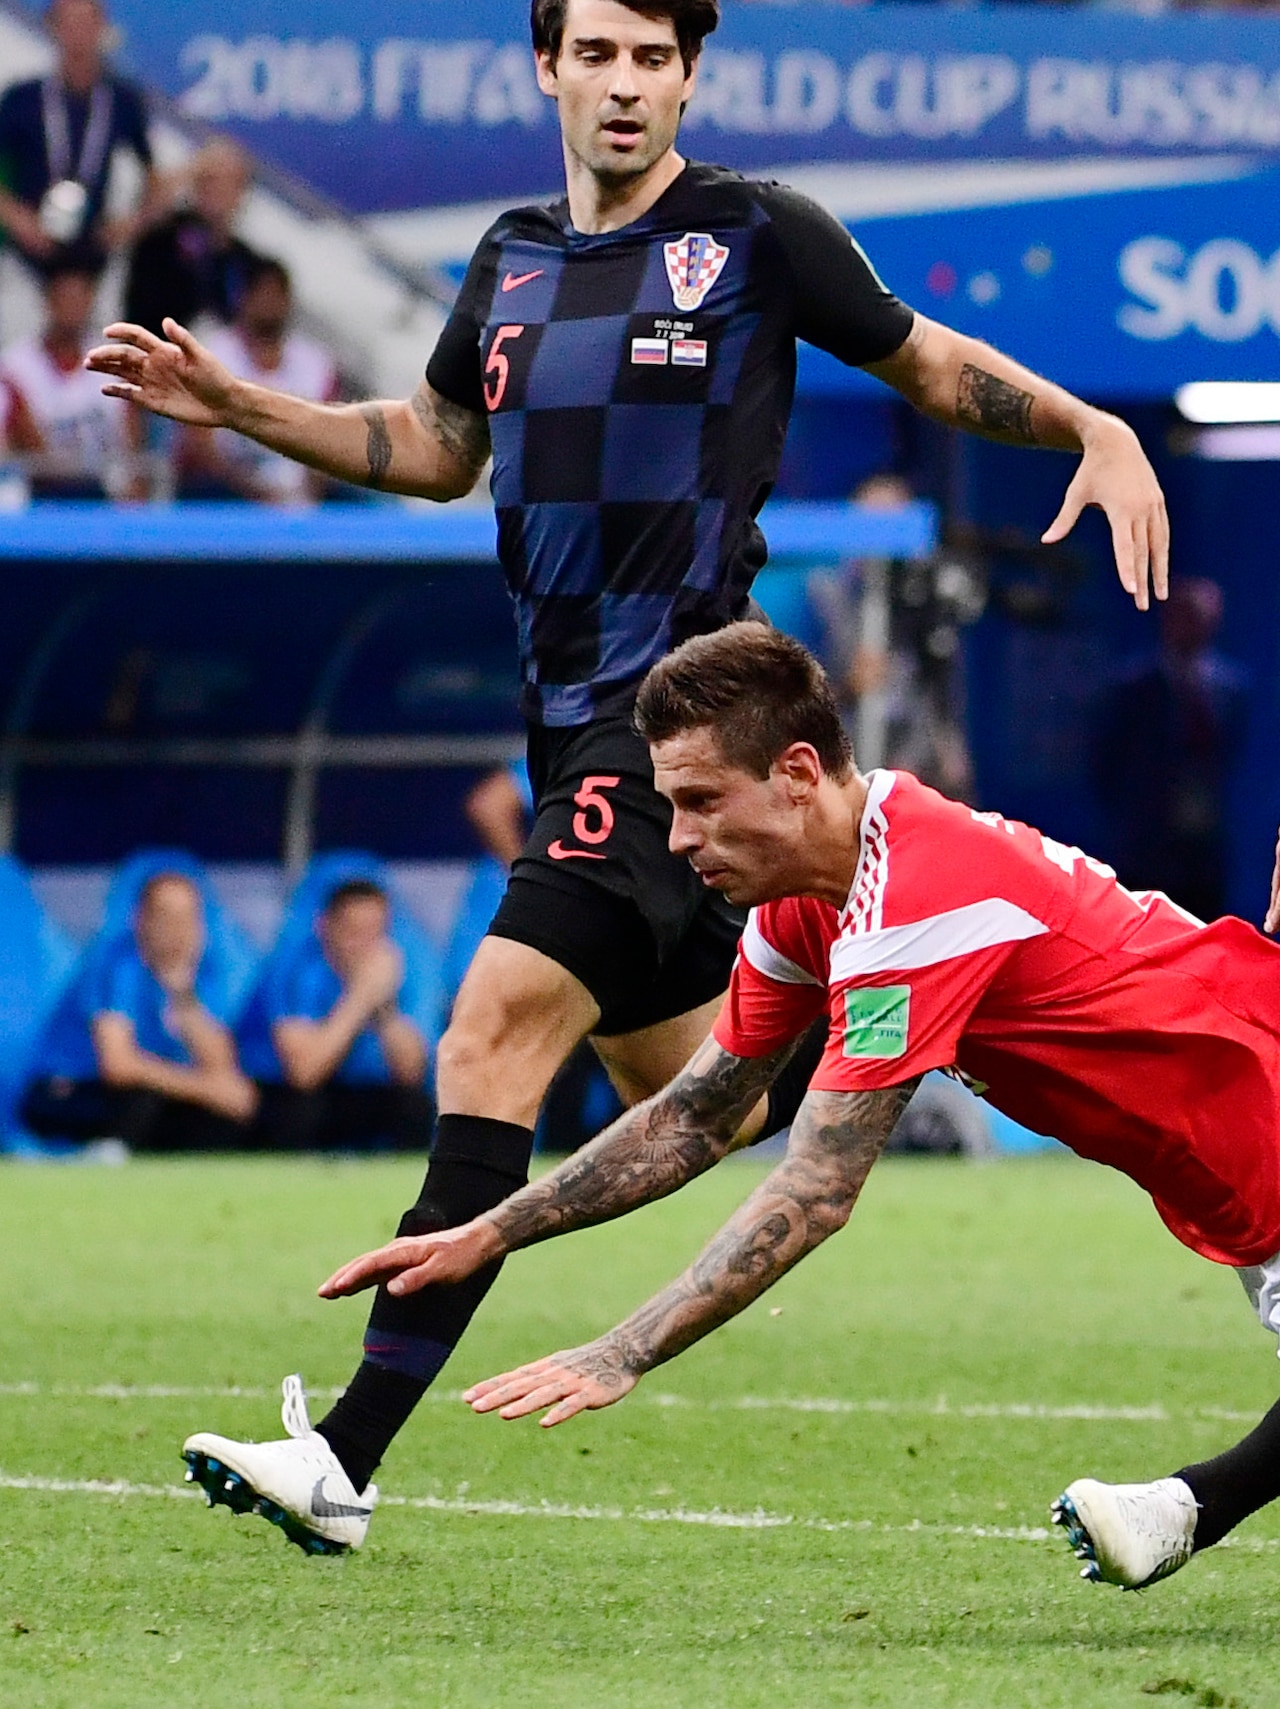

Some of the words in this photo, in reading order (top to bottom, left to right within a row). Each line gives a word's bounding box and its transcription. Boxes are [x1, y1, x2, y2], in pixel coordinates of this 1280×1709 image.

[181, 36, 365, 121] 2018
[374, 40, 544, 126] FIFA
[682, 49, 838, 134] RLD
[847, 53, 1015, 139] CUP
[484, 325, 524, 411] 5
[573, 776, 620, 844] 5
